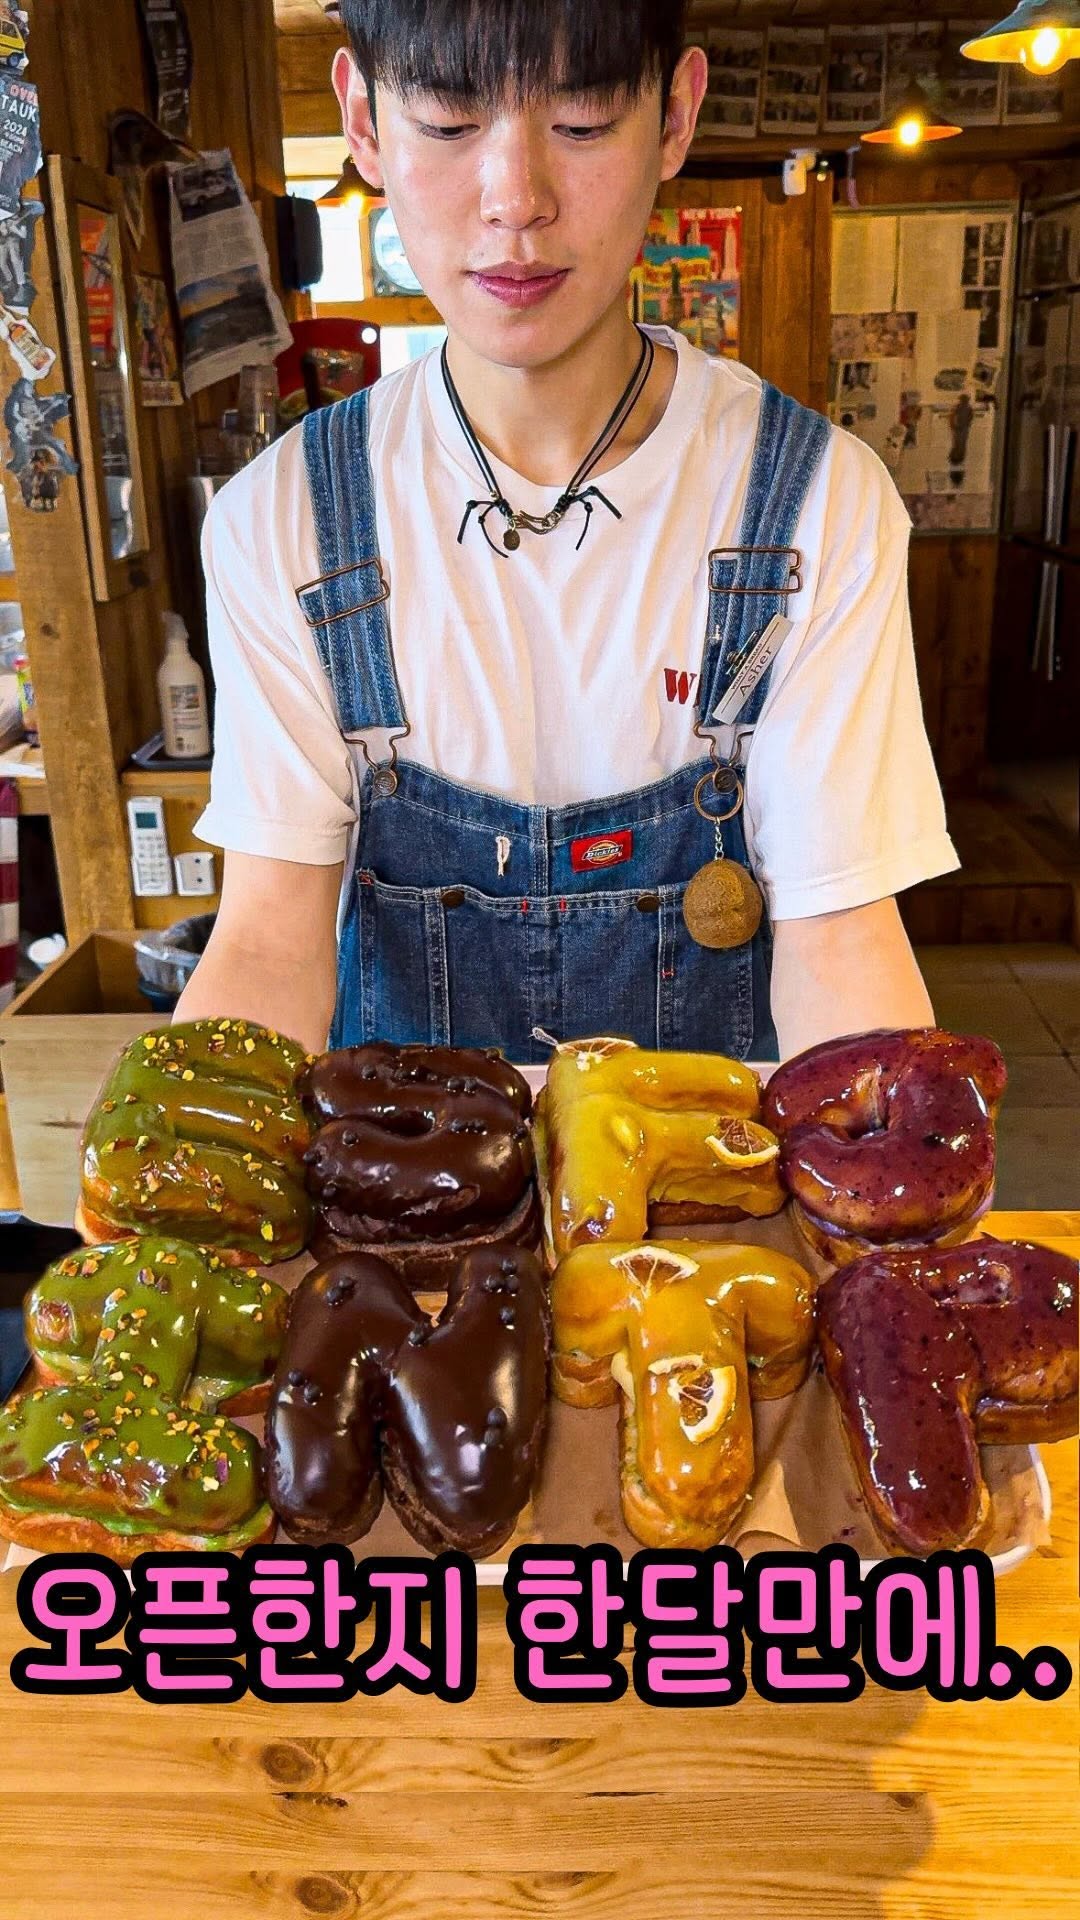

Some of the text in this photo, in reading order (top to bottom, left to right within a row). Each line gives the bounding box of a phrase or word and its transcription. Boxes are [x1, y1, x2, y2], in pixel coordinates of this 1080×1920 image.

[3, 119, 27, 137] 2024
[739, 646, 772, 697] Asher
[586, 845, 620, 860] Dickies
